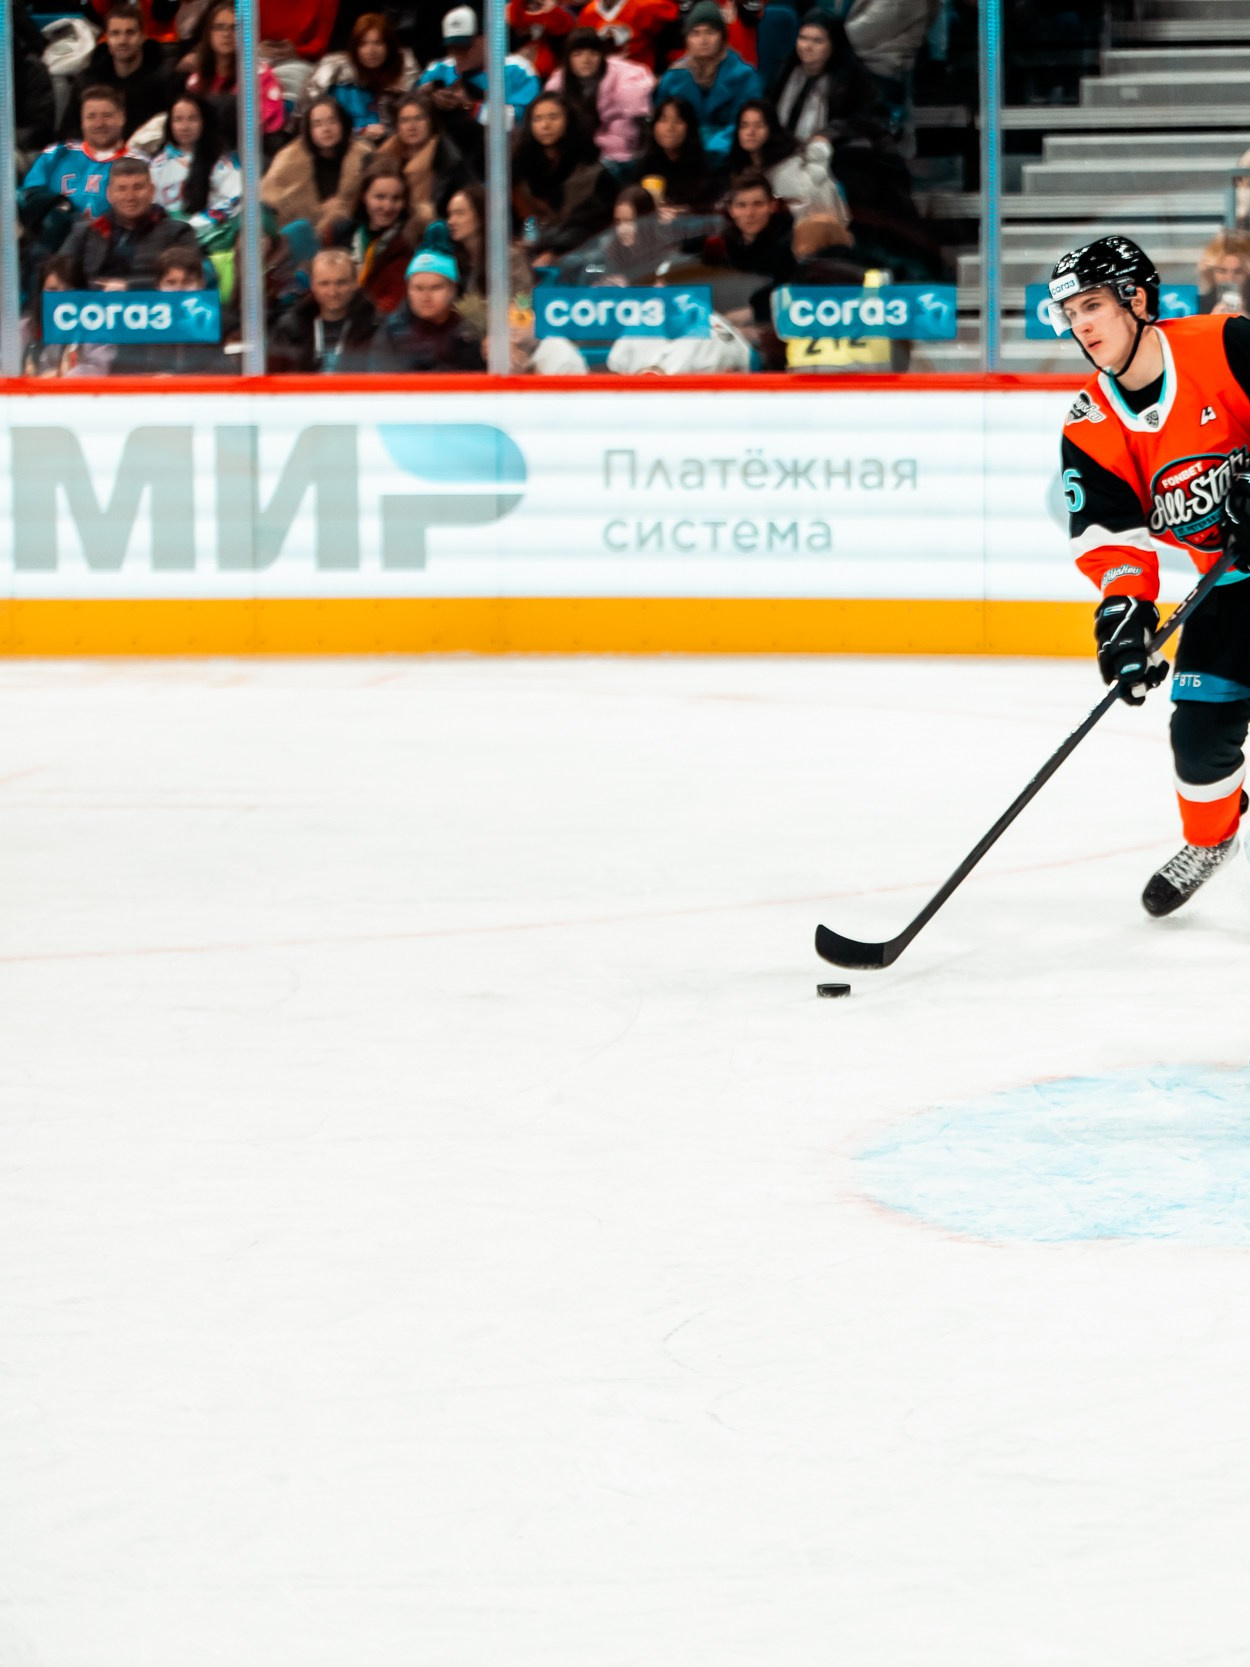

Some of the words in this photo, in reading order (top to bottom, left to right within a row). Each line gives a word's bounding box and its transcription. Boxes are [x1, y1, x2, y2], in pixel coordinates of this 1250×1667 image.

[53, 303, 172, 332] согаз
[545, 298, 665, 328] согаз
[789, 298, 908, 327] согаз
[602, 447, 919, 491] Платёжная
[1161, 461, 1204, 489] FONBET
[8, 424, 528, 572] МИР
[602, 517, 834, 553] система
